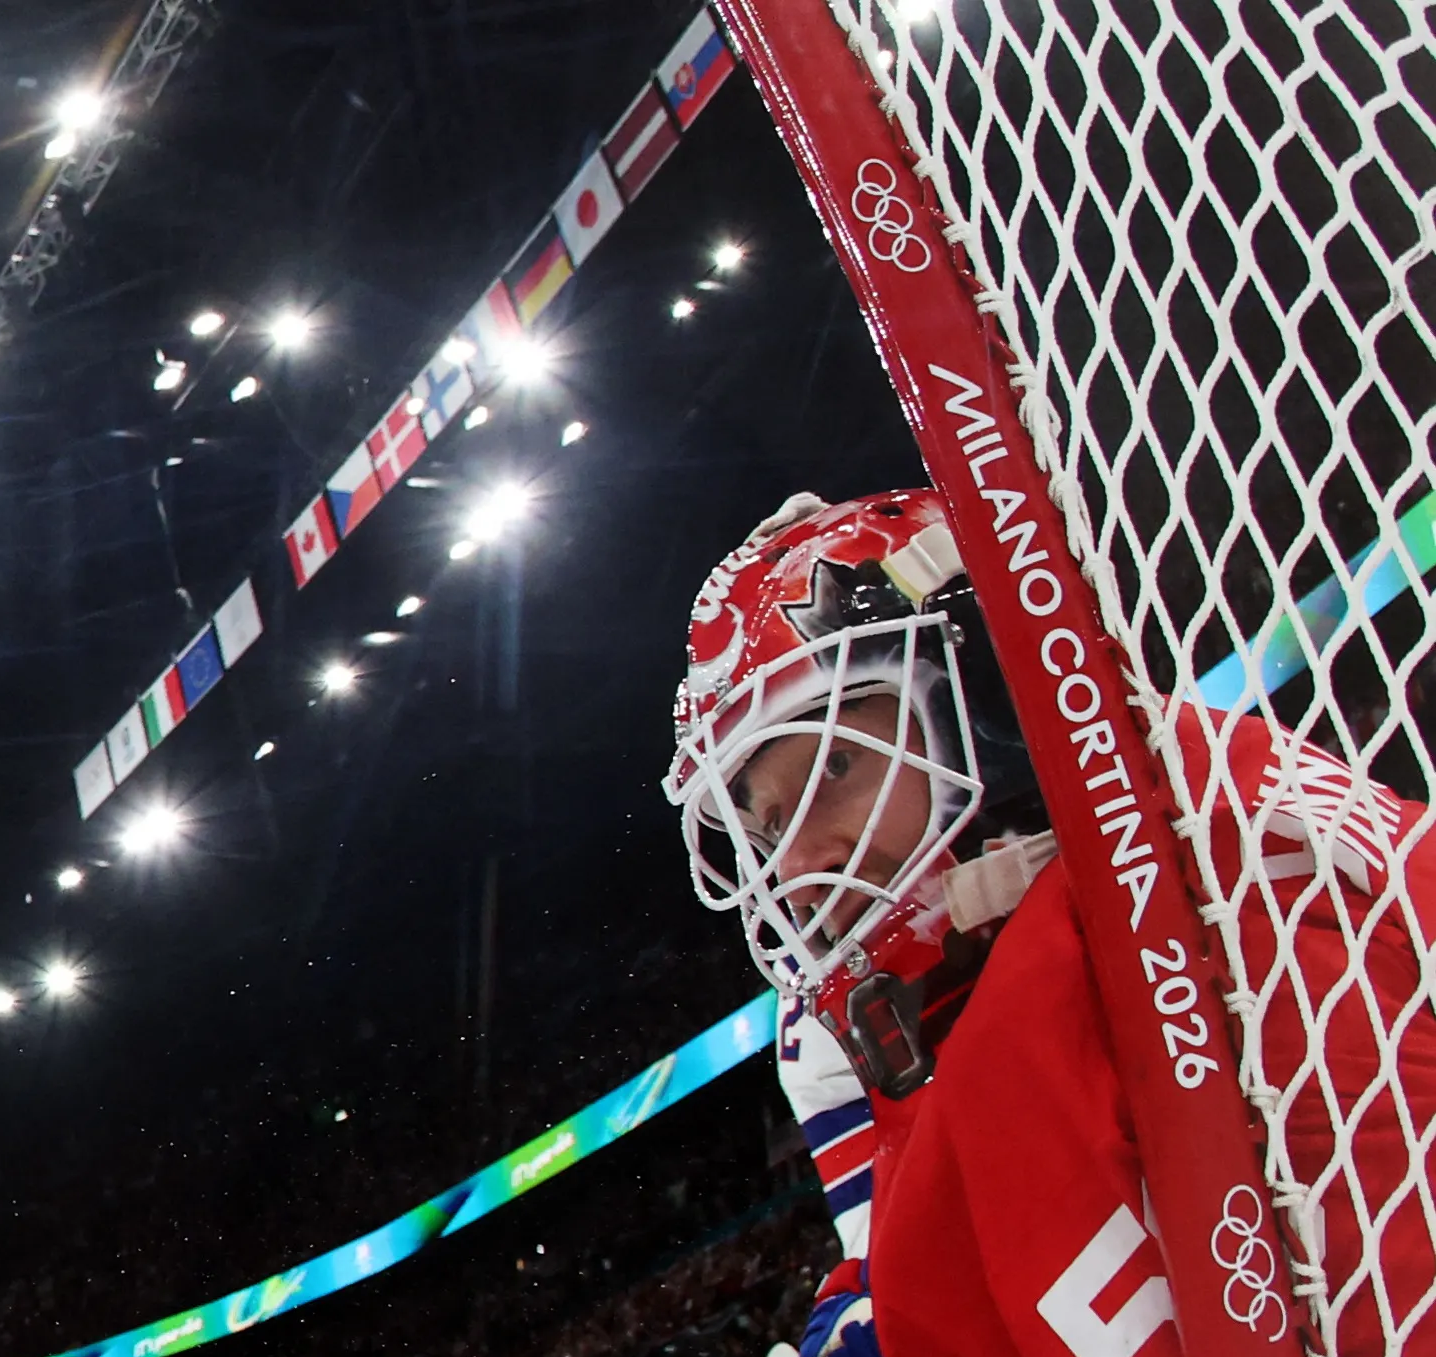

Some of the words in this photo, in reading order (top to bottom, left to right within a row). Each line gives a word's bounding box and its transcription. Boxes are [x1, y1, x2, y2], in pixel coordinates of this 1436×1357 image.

[928, 362, 1064, 618] MILANO
[1038, 626, 1161, 934] CORTINA
[1140, 938, 1219, 1091] 2026
